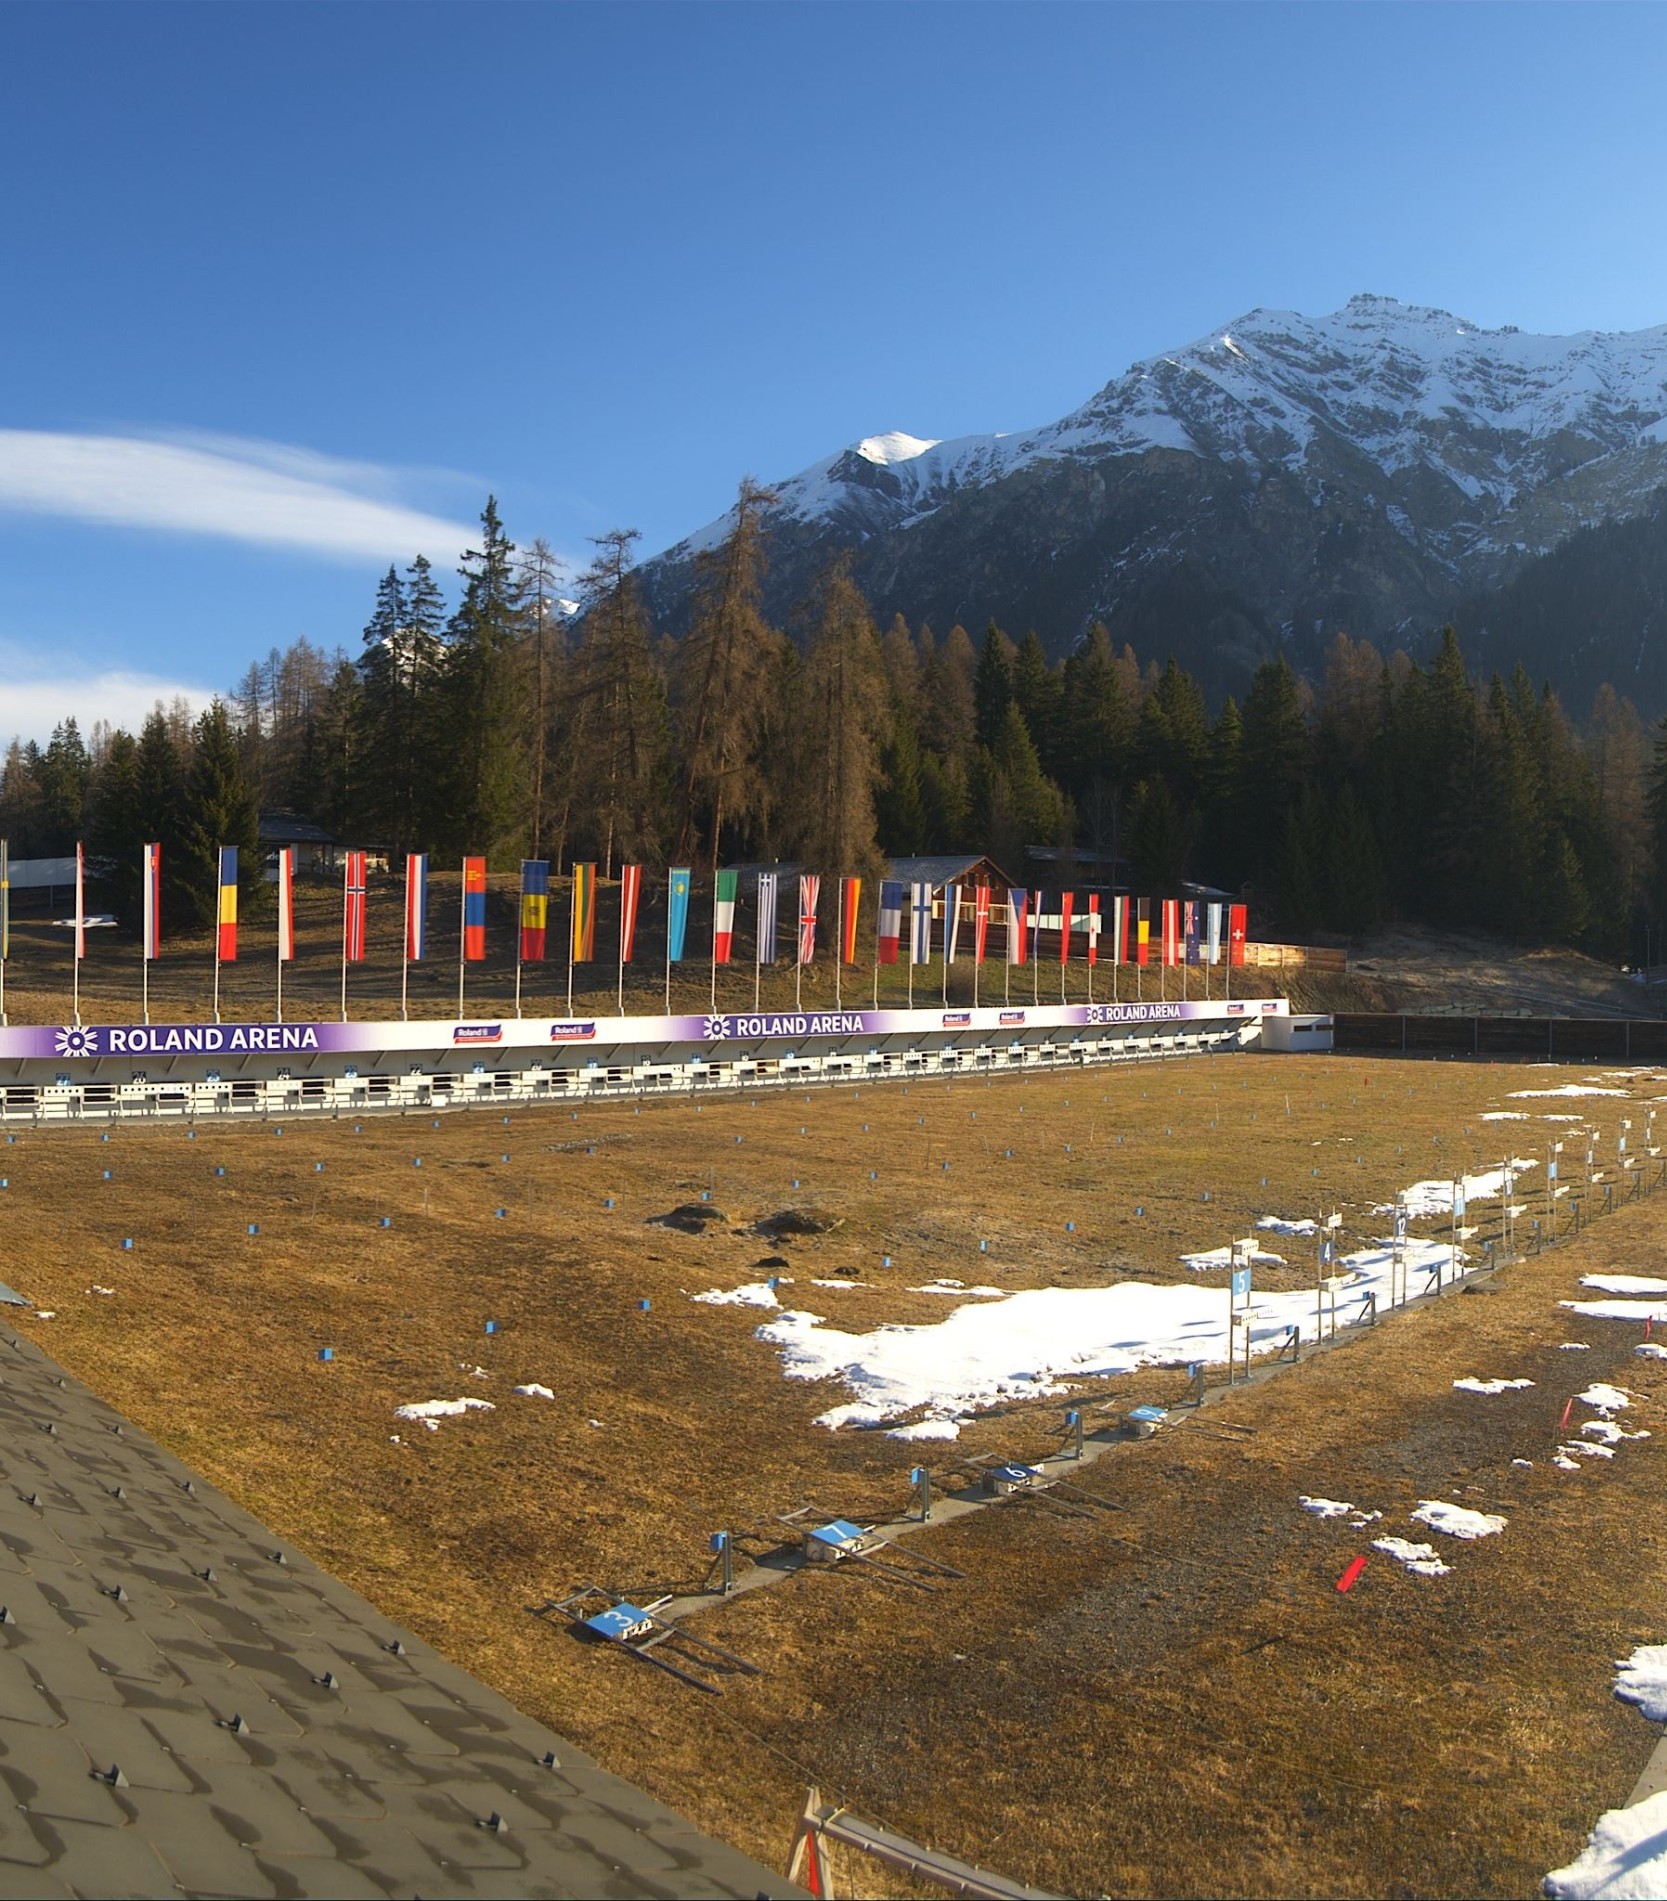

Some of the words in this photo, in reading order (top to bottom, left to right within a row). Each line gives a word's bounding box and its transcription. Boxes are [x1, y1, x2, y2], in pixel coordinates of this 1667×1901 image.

[1105, 1005, 1147, 1021] ROLAND
[1149, 1004, 1180, 1018] ARENA
[458, 1027, 482, 1037] Roland
[554, 1025, 577, 1034] Roland
[736, 1018, 807, 1037] ROLAND
[810, 1015, 864, 1035] ARENA
[109, 1028, 224, 1051] ROLAND
[229, 1027, 319, 1049] ARENA
[277, 1067, 291, 1080] 24
[1397, 1216, 1406, 1236] 12
[1324, 1242, 1331, 1262] 4
[1238, 1271, 1246, 1286] 5
